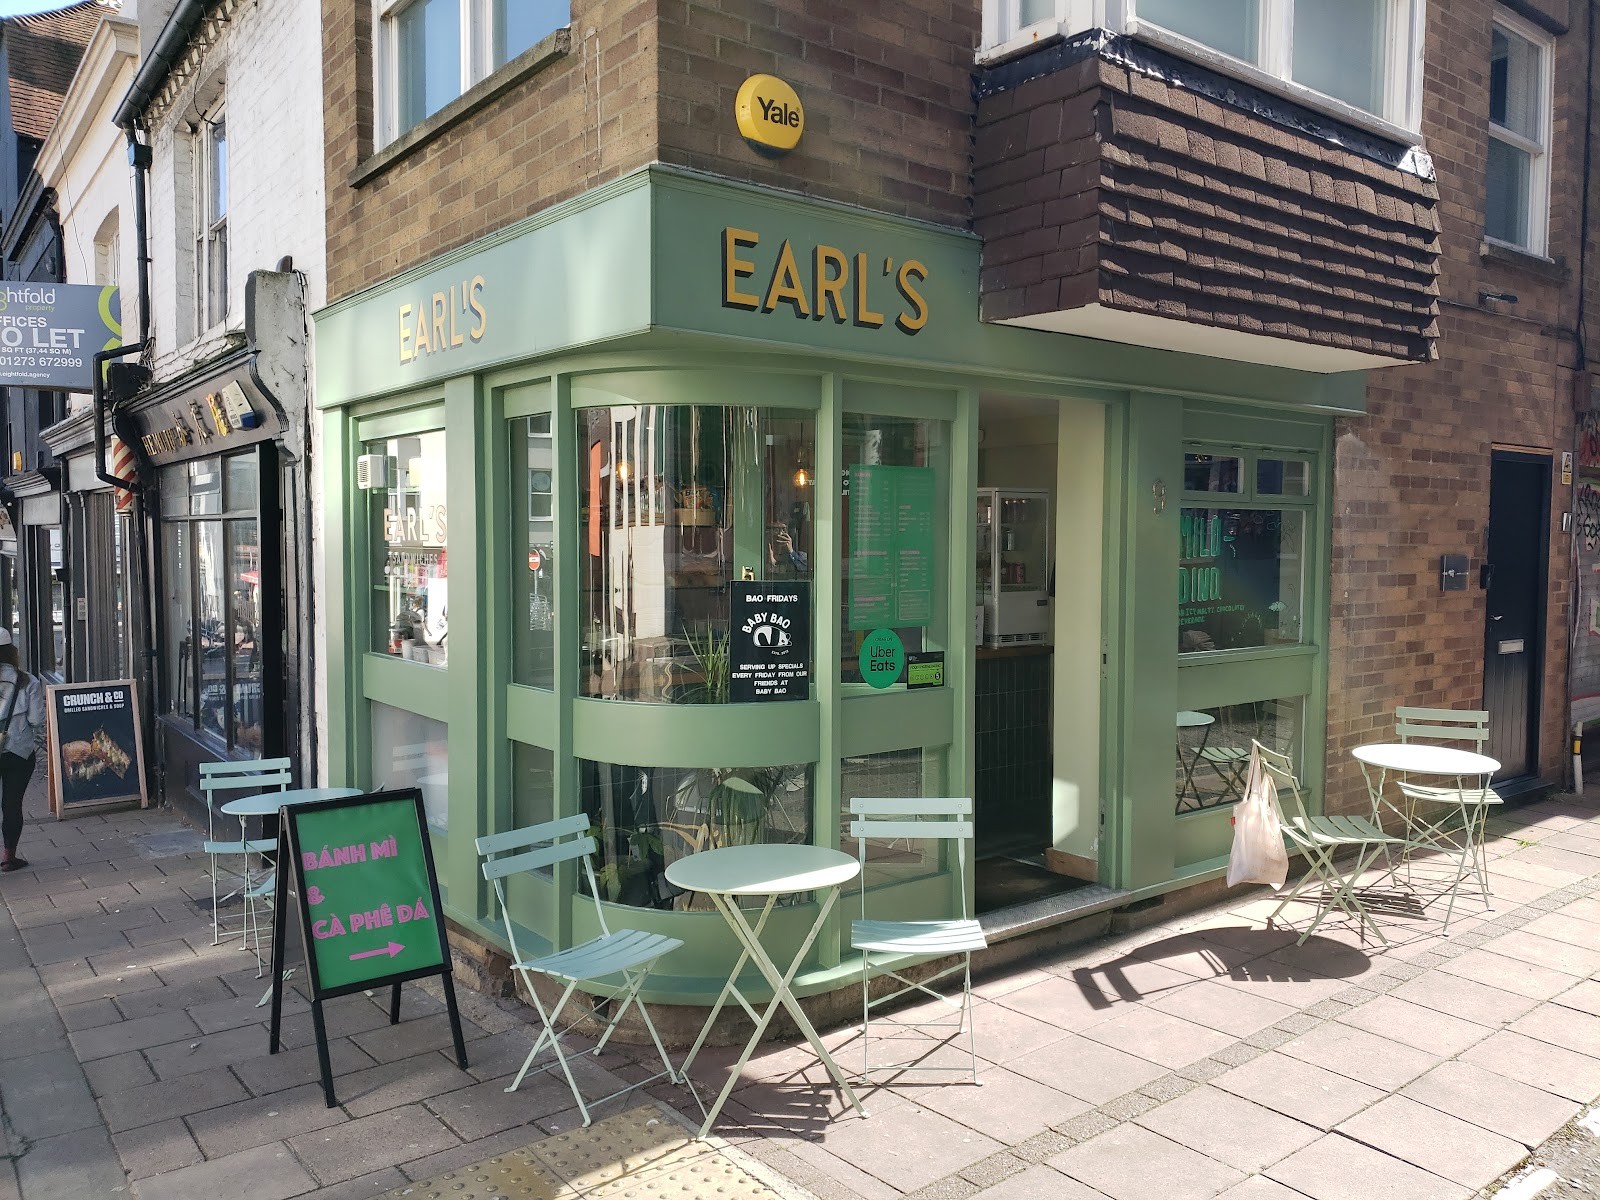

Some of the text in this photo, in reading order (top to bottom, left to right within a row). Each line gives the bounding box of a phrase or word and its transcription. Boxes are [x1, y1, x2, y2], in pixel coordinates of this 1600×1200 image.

[757, 96, 799, 128] Yale
[721, 226, 929, 336] EARL'S
[25, 304, 55, 313] property
[399, 274, 487, 366] EARL'S
[32, 327, 85, 349] LET
[0, 356, 83, 368] 01273 672999
[383, 504, 447, 544] EARL'S
[741, 612, 791, 634] BABY BAO
[870, 645, 897, 658] Uber
[777, 662, 804, 670] SPECIALS
[870, 659, 897, 672] Eats
[934, 672, 941, 680] 5
[63, 690, 124, 707] CRUNCH & CO
[302, 834, 398, 871] BÁNH MÌ
[306, 885, 326, 905] &
[311, 912, 347, 940] CÀ
[348, 902, 394, 933] PHÊ
